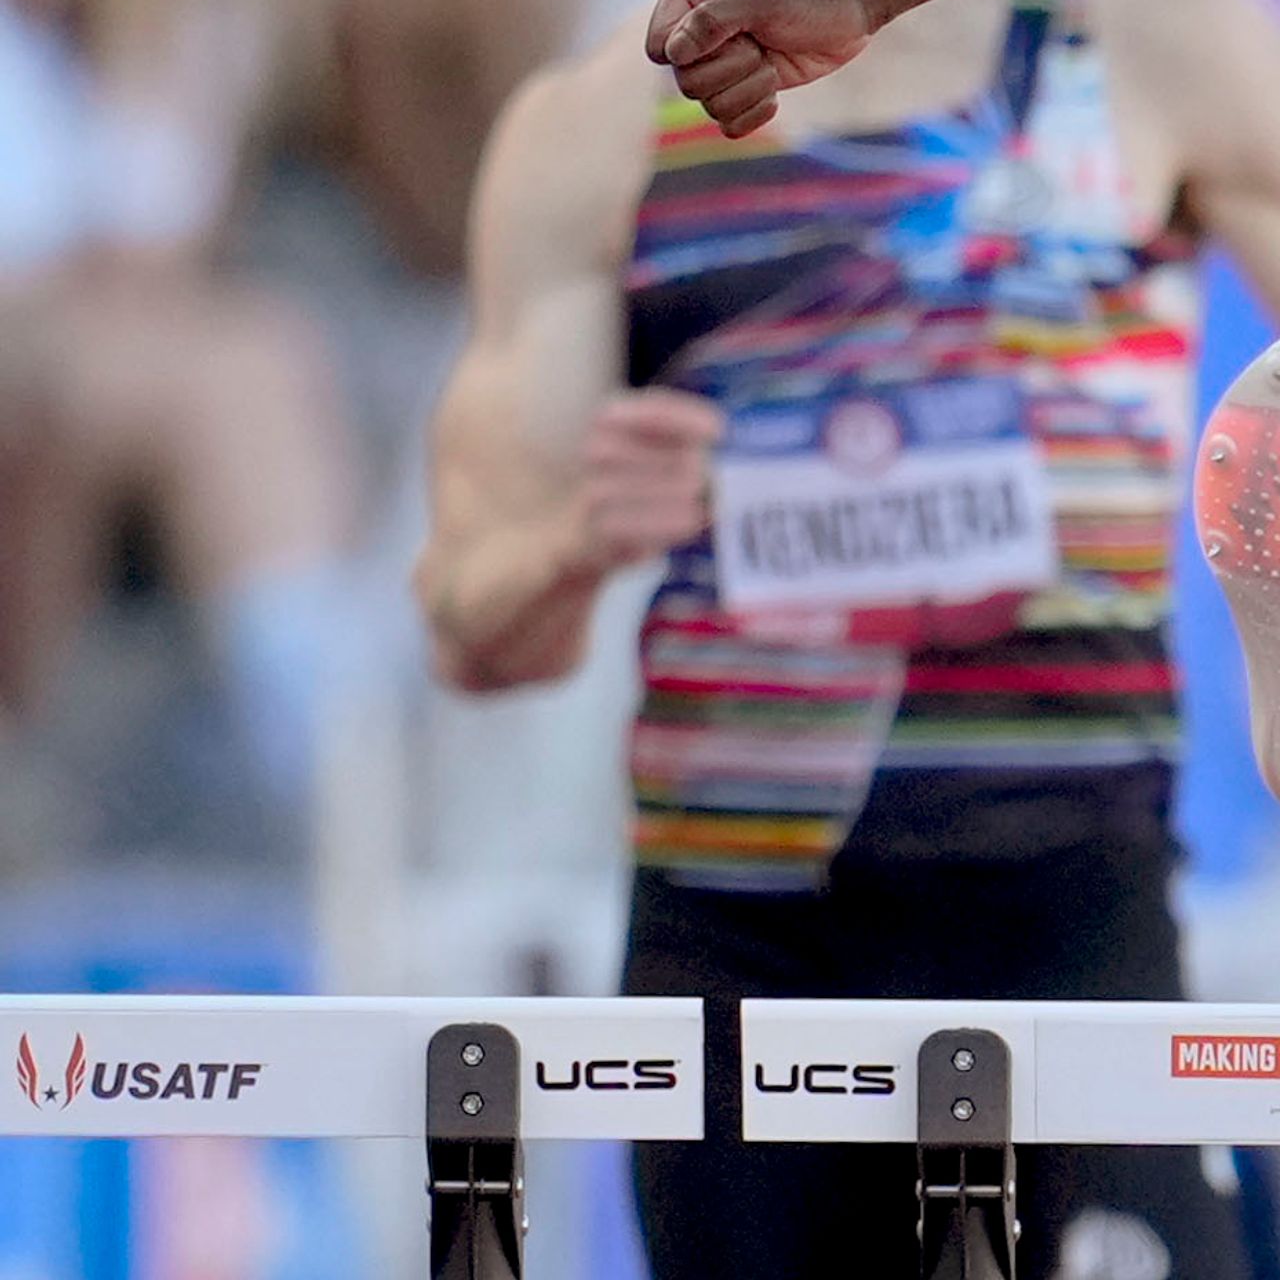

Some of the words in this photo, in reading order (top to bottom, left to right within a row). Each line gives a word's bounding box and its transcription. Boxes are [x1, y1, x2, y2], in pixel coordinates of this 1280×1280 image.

[1179, 1042, 1276, 1072] MAKING
[91, 1062, 261, 1100] USATF
[536, 1059, 676, 1091] UCS
[755, 1063, 896, 1095] UCS
